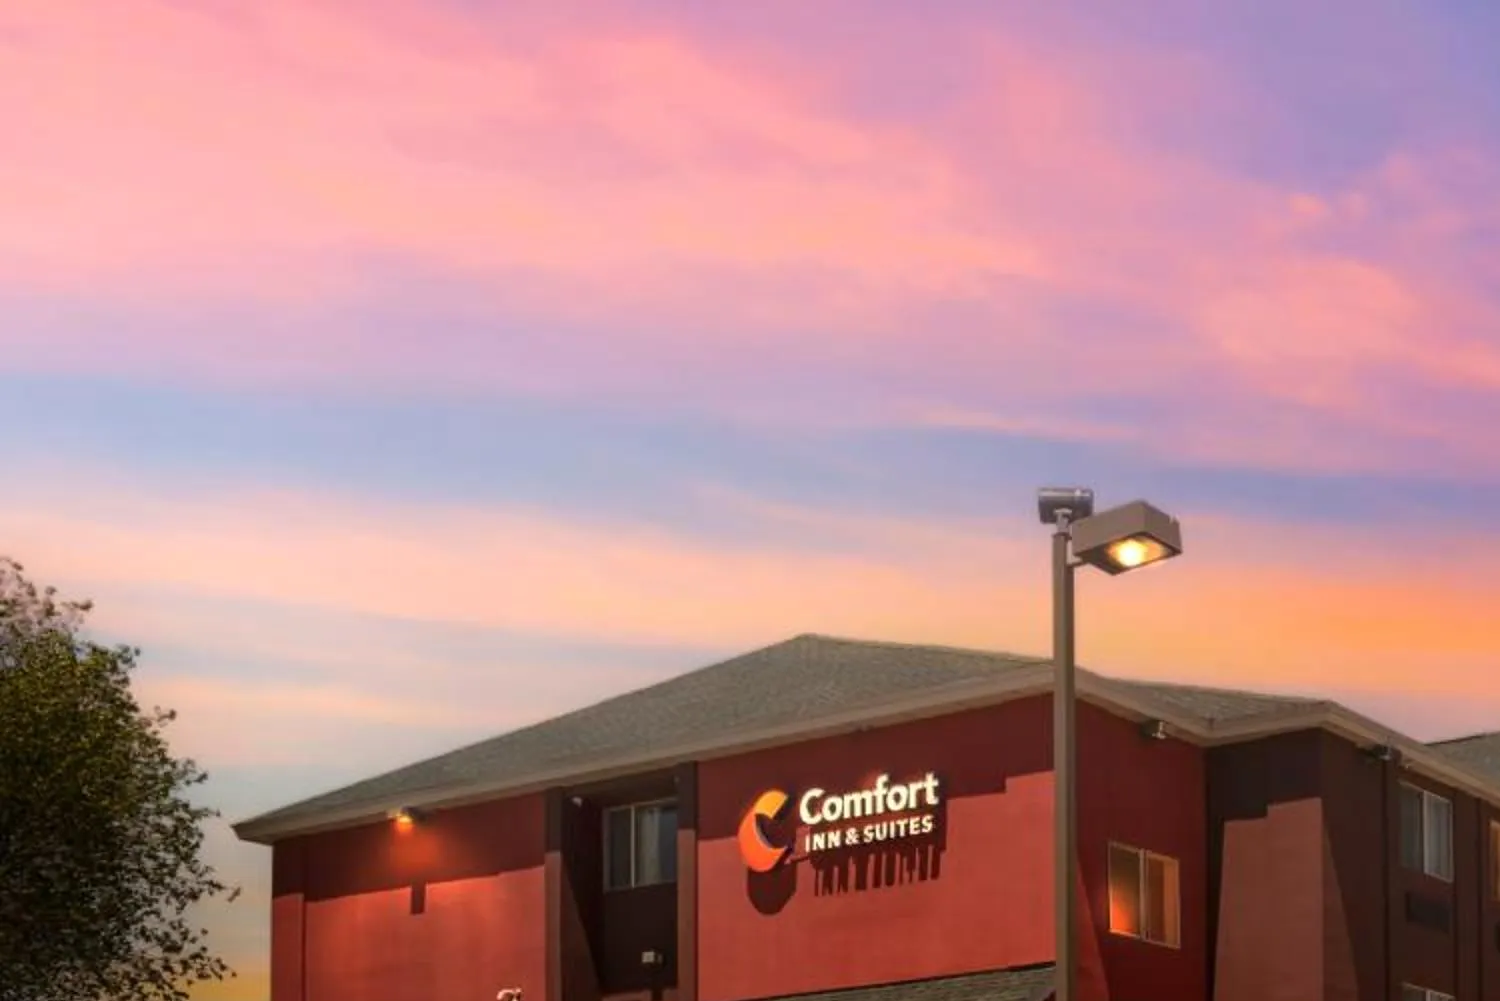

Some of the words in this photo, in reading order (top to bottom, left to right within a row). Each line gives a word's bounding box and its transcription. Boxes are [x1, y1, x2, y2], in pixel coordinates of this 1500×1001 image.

[799, 771, 939, 825] Comfort
[805, 829, 841, 853] INN
[845, 829, 859, 846] &
[863, 814, 934, 843] SUITES
